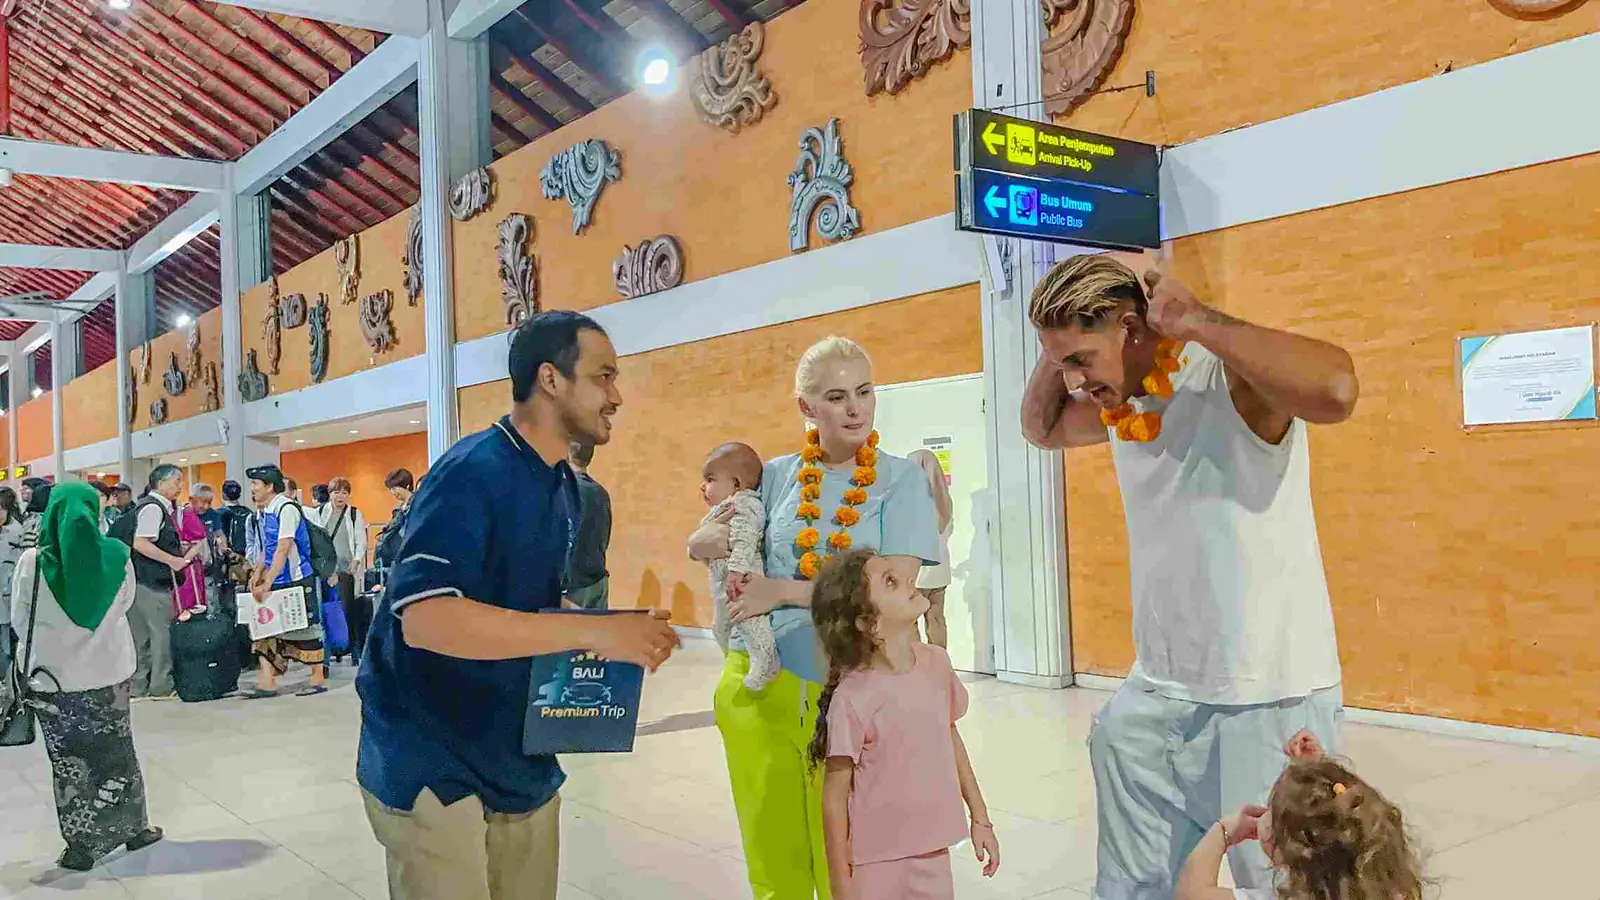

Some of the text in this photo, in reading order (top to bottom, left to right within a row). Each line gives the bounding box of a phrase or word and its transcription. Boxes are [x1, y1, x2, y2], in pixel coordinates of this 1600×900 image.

[1038, 131, 1115, 156] Area Penjemputan
[1038, 151, 1092, 172] Arrival Pick-Up
[1040, 193, 1092, 212] Bus Umum
[1040, 212, 1084, 228] Public Bus
[572, 667, 605, 680] BALI
[540, 704, 626, 719] Premium Trip
